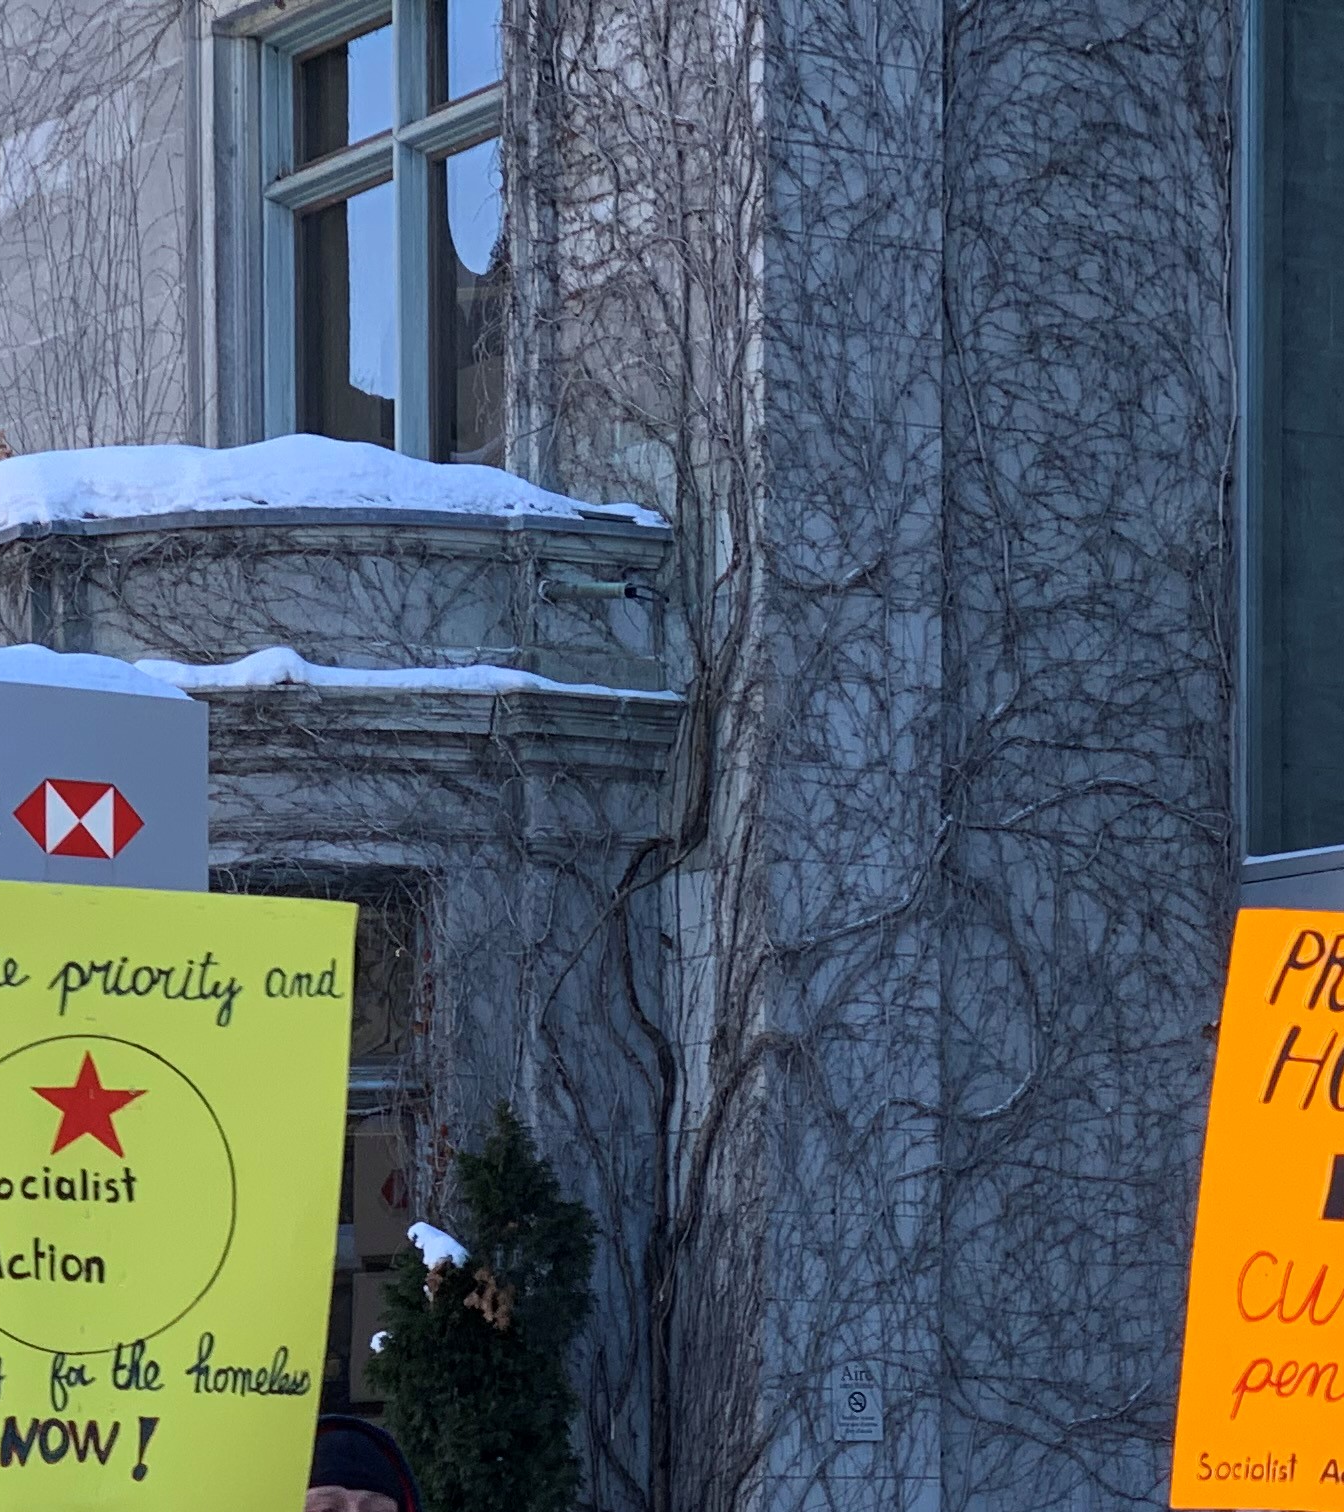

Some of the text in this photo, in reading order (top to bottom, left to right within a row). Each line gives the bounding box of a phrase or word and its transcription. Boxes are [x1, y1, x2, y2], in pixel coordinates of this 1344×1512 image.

[48, 952, 243, 1028] priority
[264, 958, 344, 999] and
[50, 1351, 96, 1412] for
[112, 1338, 165, 1392] the
[185, 1331, 312, 1398] homeless
